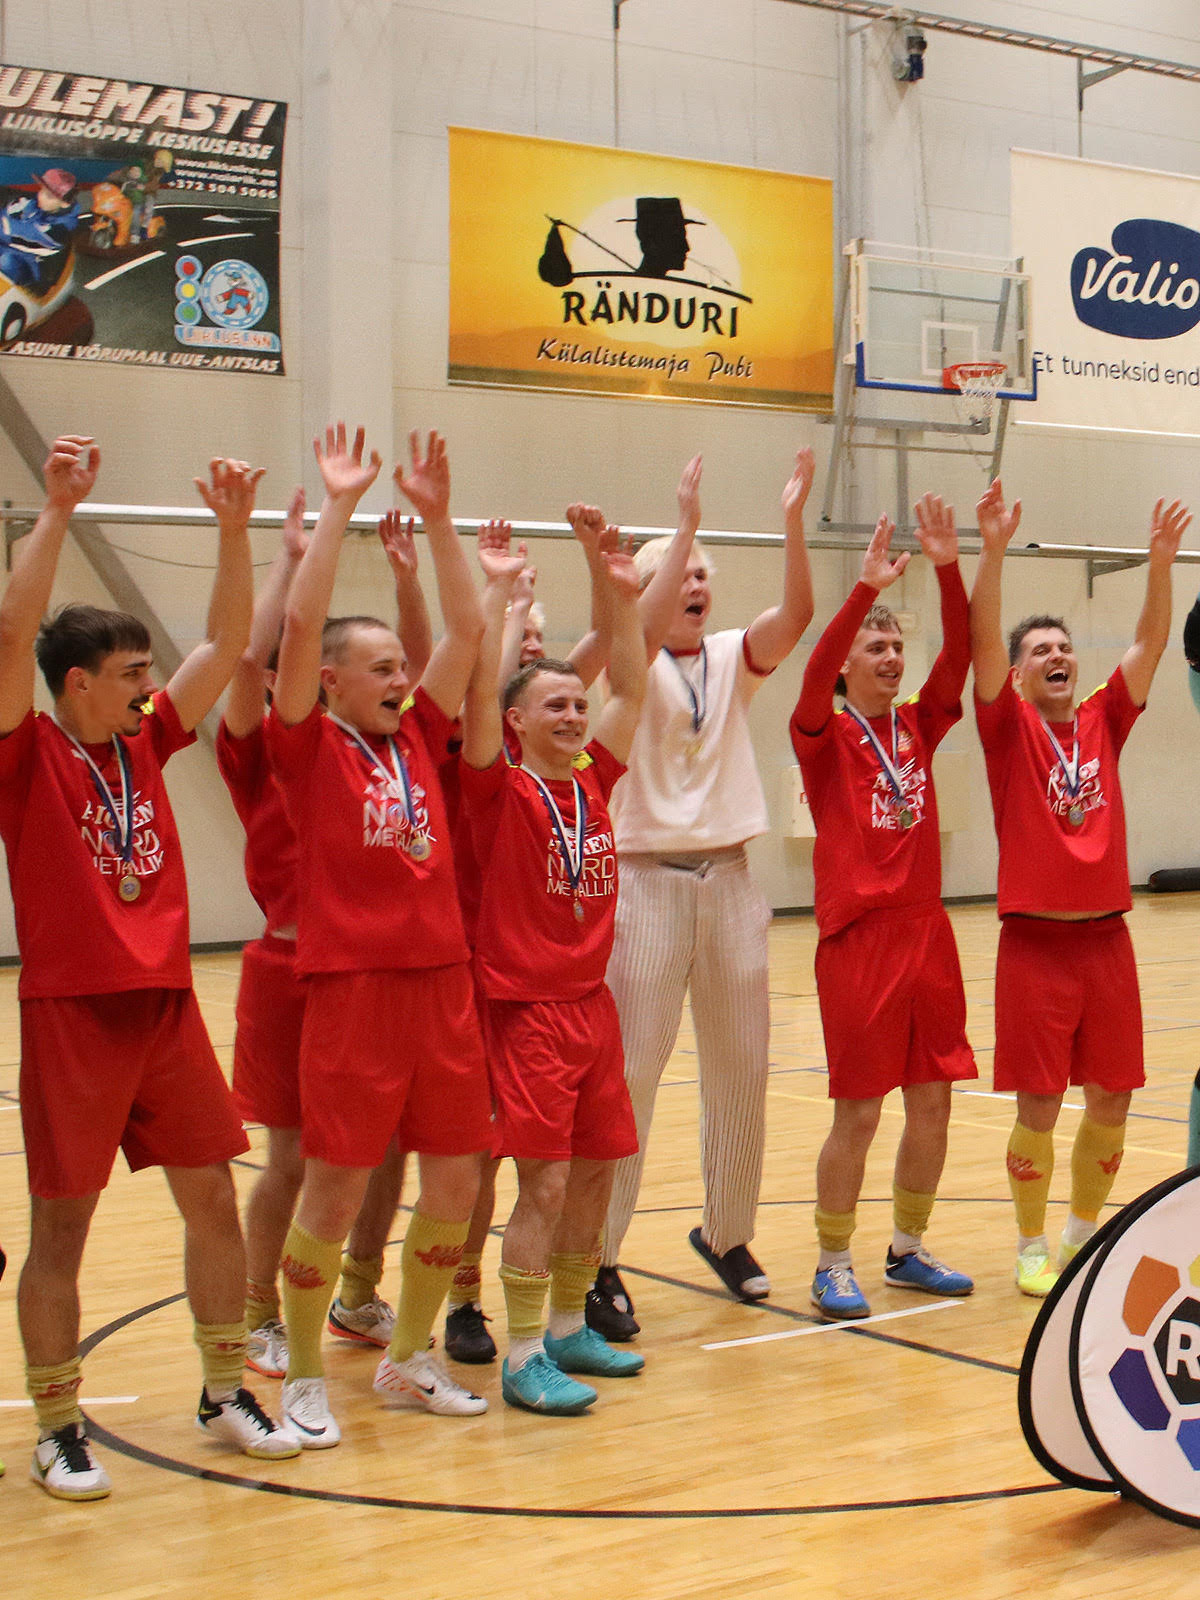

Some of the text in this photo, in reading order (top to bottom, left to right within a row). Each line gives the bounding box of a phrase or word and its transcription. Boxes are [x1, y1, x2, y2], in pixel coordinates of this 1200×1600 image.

[146, 131, 275, 160] KESKUSESSE
[1080, 255, 1200, 310] Valio
[561, 281, 738, 338] RÄNDURI
[9, 341, 280, 372] ASUME VÕRUMAAL UUE-ANTSLAS
[536, 337, 753, 380] Külalistemaja Pubi
[1062, 355, 1160, 383] tunneksid
[1164, 367, 1200, 387] end
